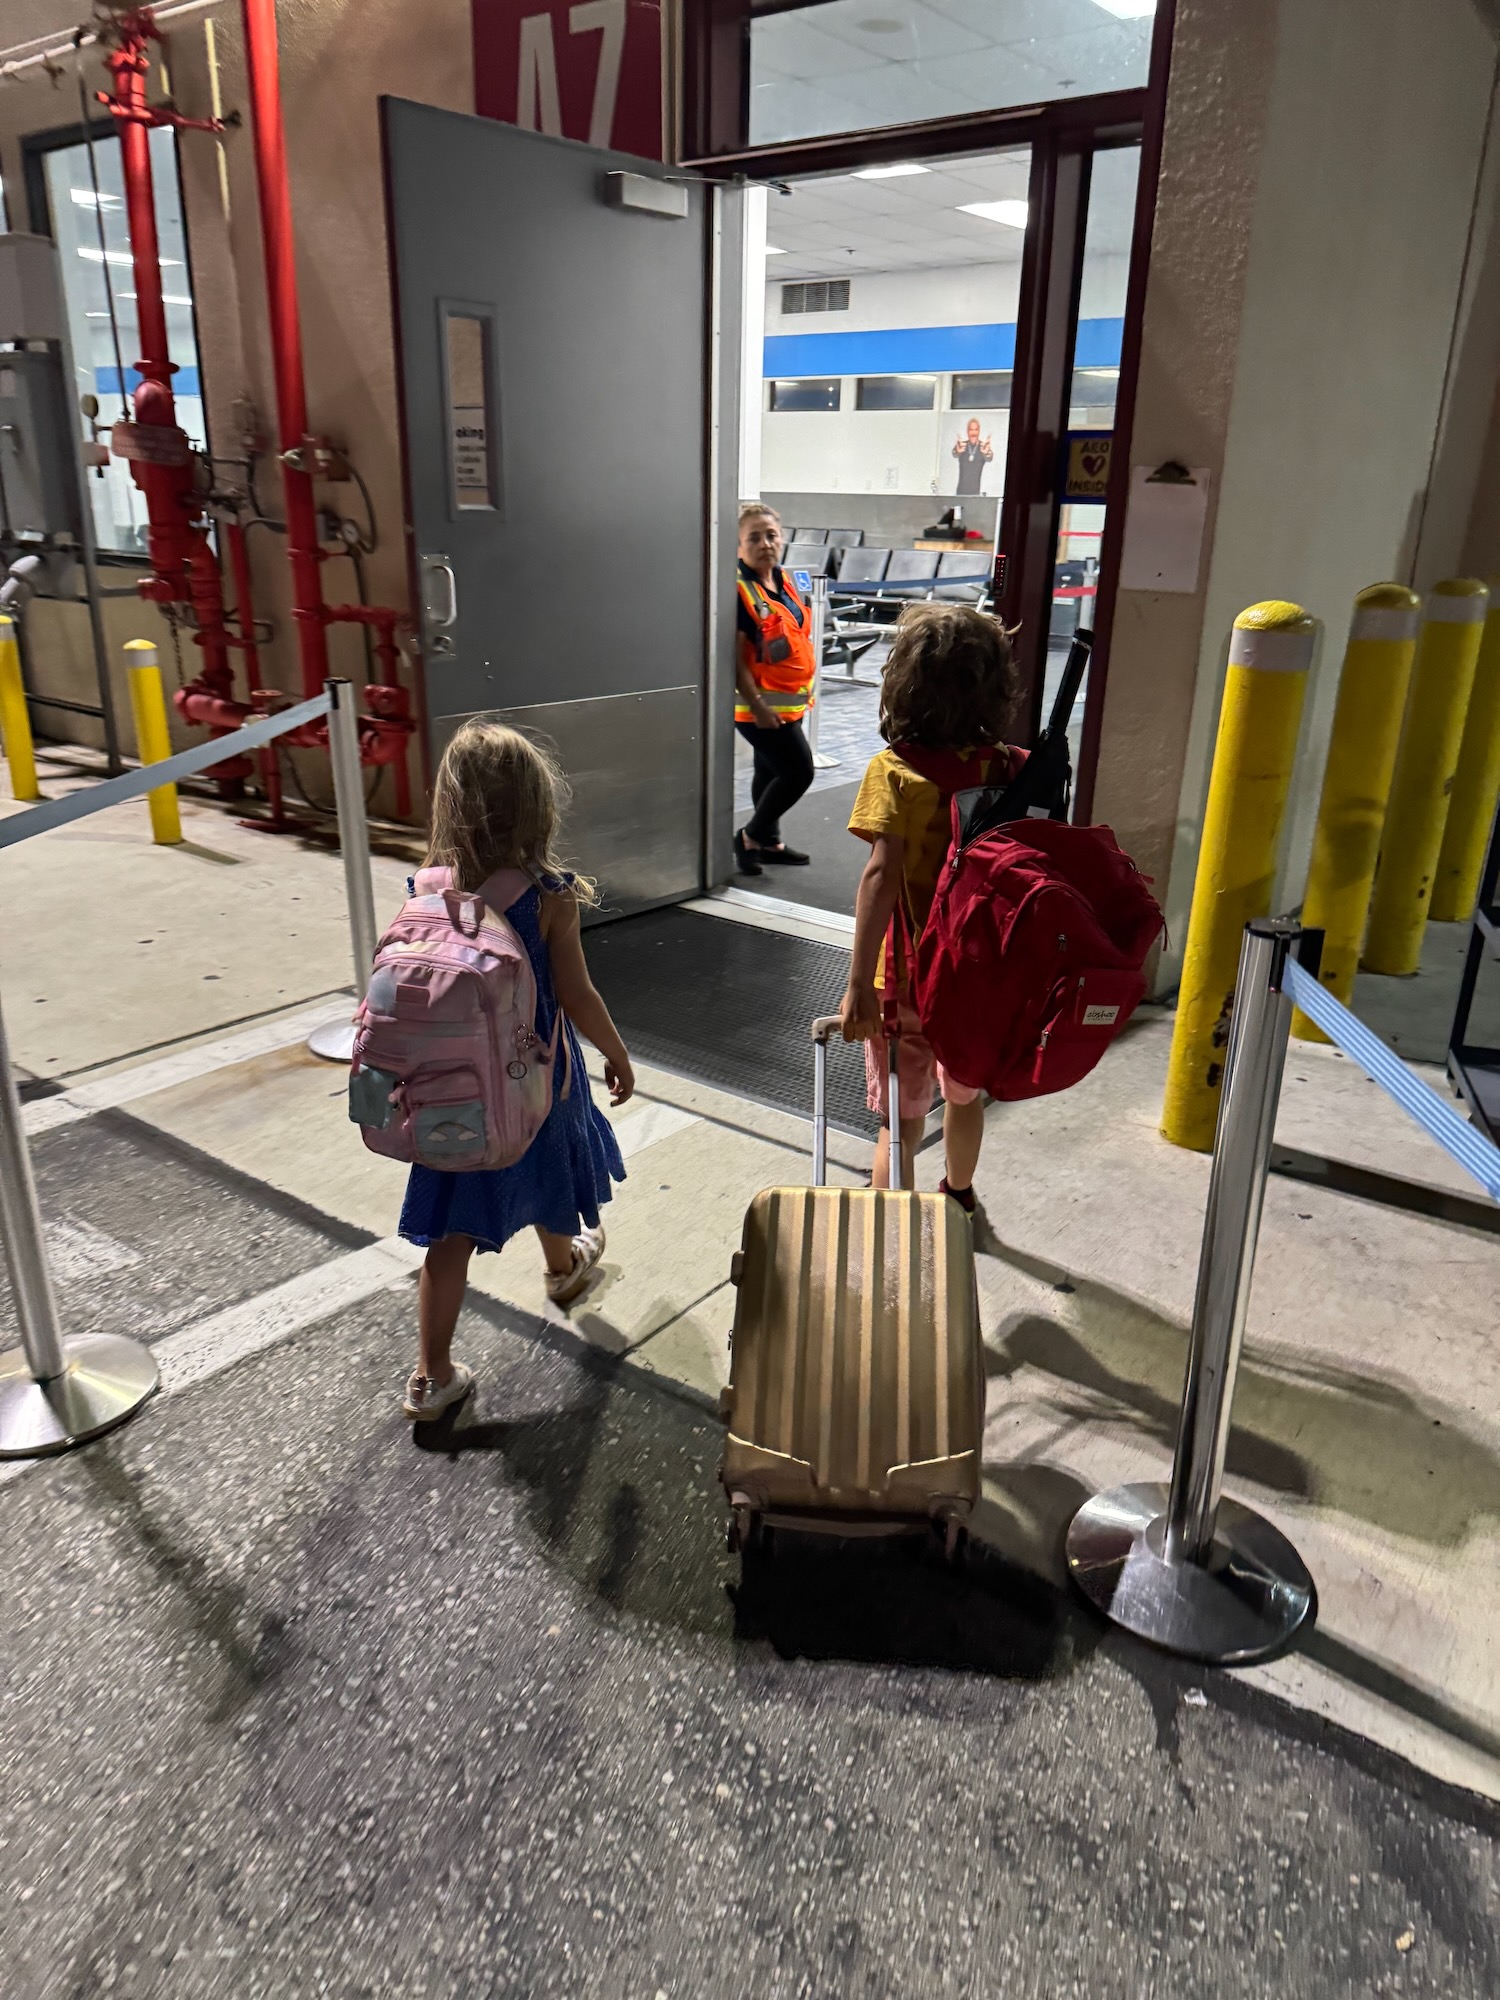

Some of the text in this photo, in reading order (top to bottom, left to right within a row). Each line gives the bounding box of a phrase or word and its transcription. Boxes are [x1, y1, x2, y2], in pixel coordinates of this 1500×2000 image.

[517, 0, 627, 149] A7
[456, 426, 484, 440] oking
[1068, 479, 1108, 492] INSID
